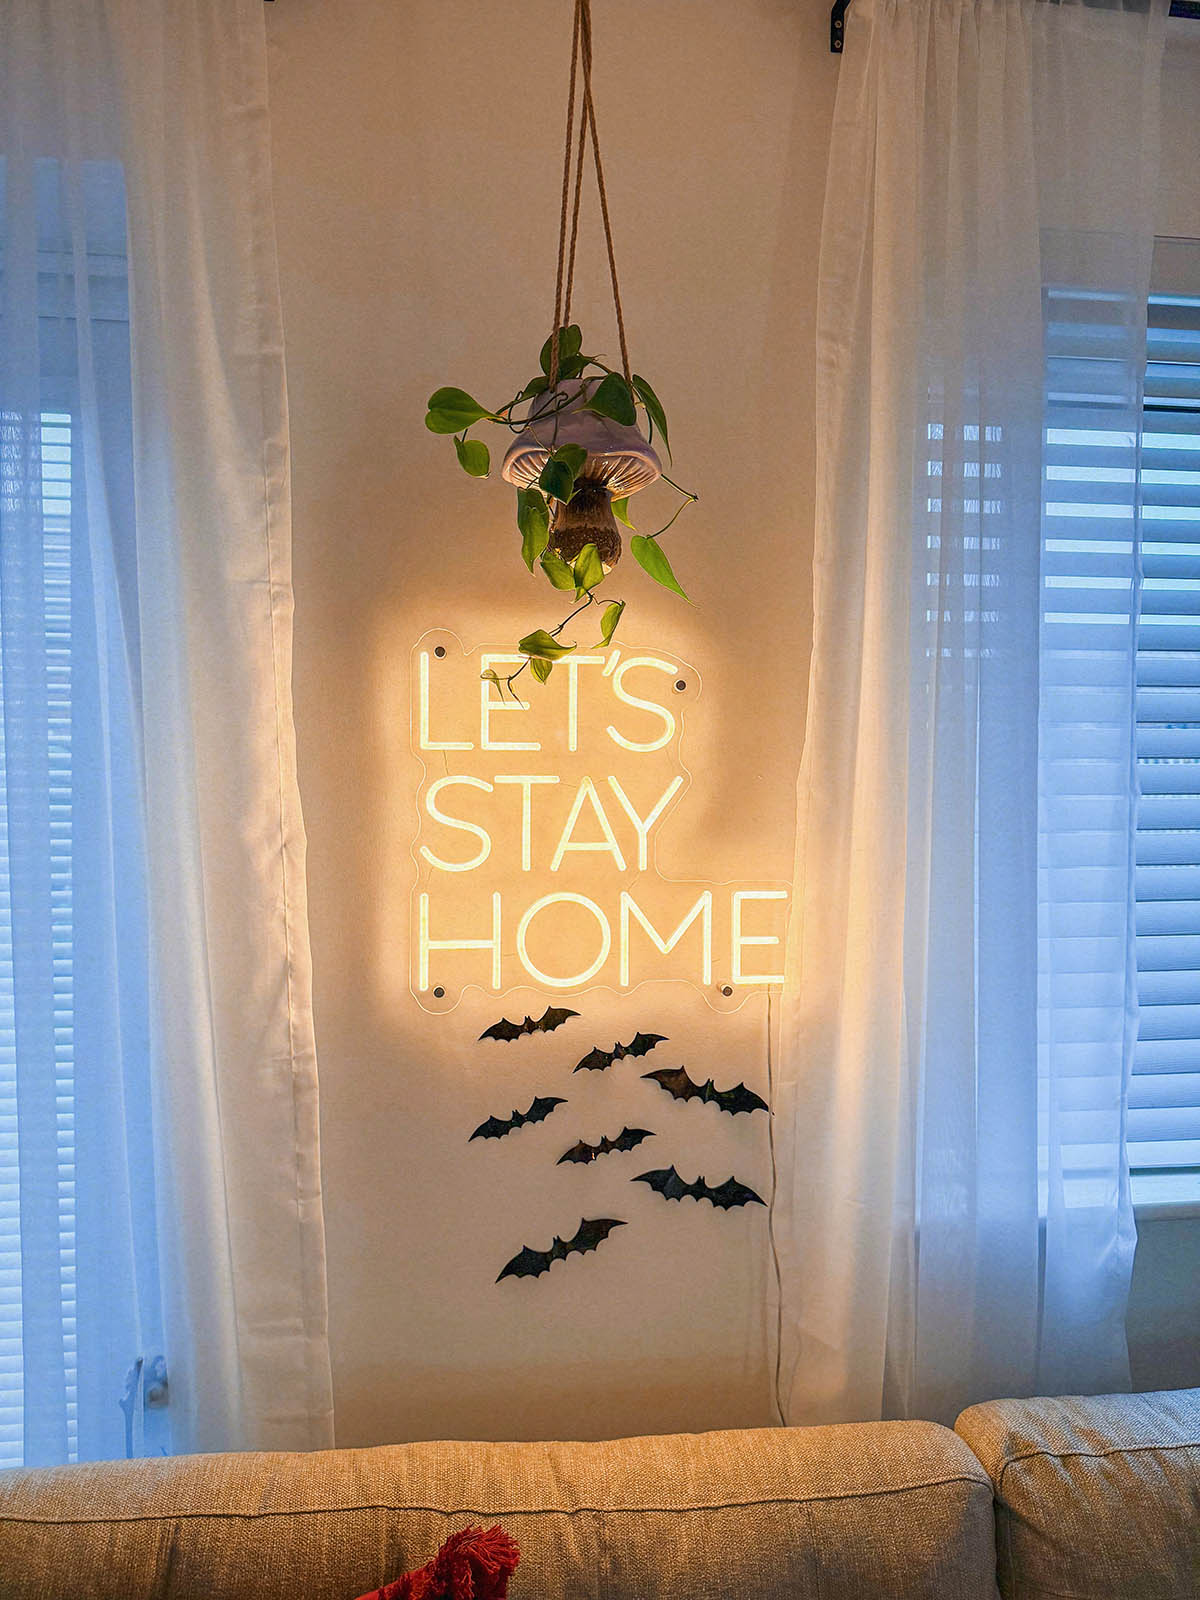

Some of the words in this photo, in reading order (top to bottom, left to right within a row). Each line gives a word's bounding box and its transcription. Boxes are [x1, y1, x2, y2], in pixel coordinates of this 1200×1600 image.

[419, 649, 679, 753] LET'S
[419, 774, 684, 872] STAY
[418, 889, 789, 992] HOME
